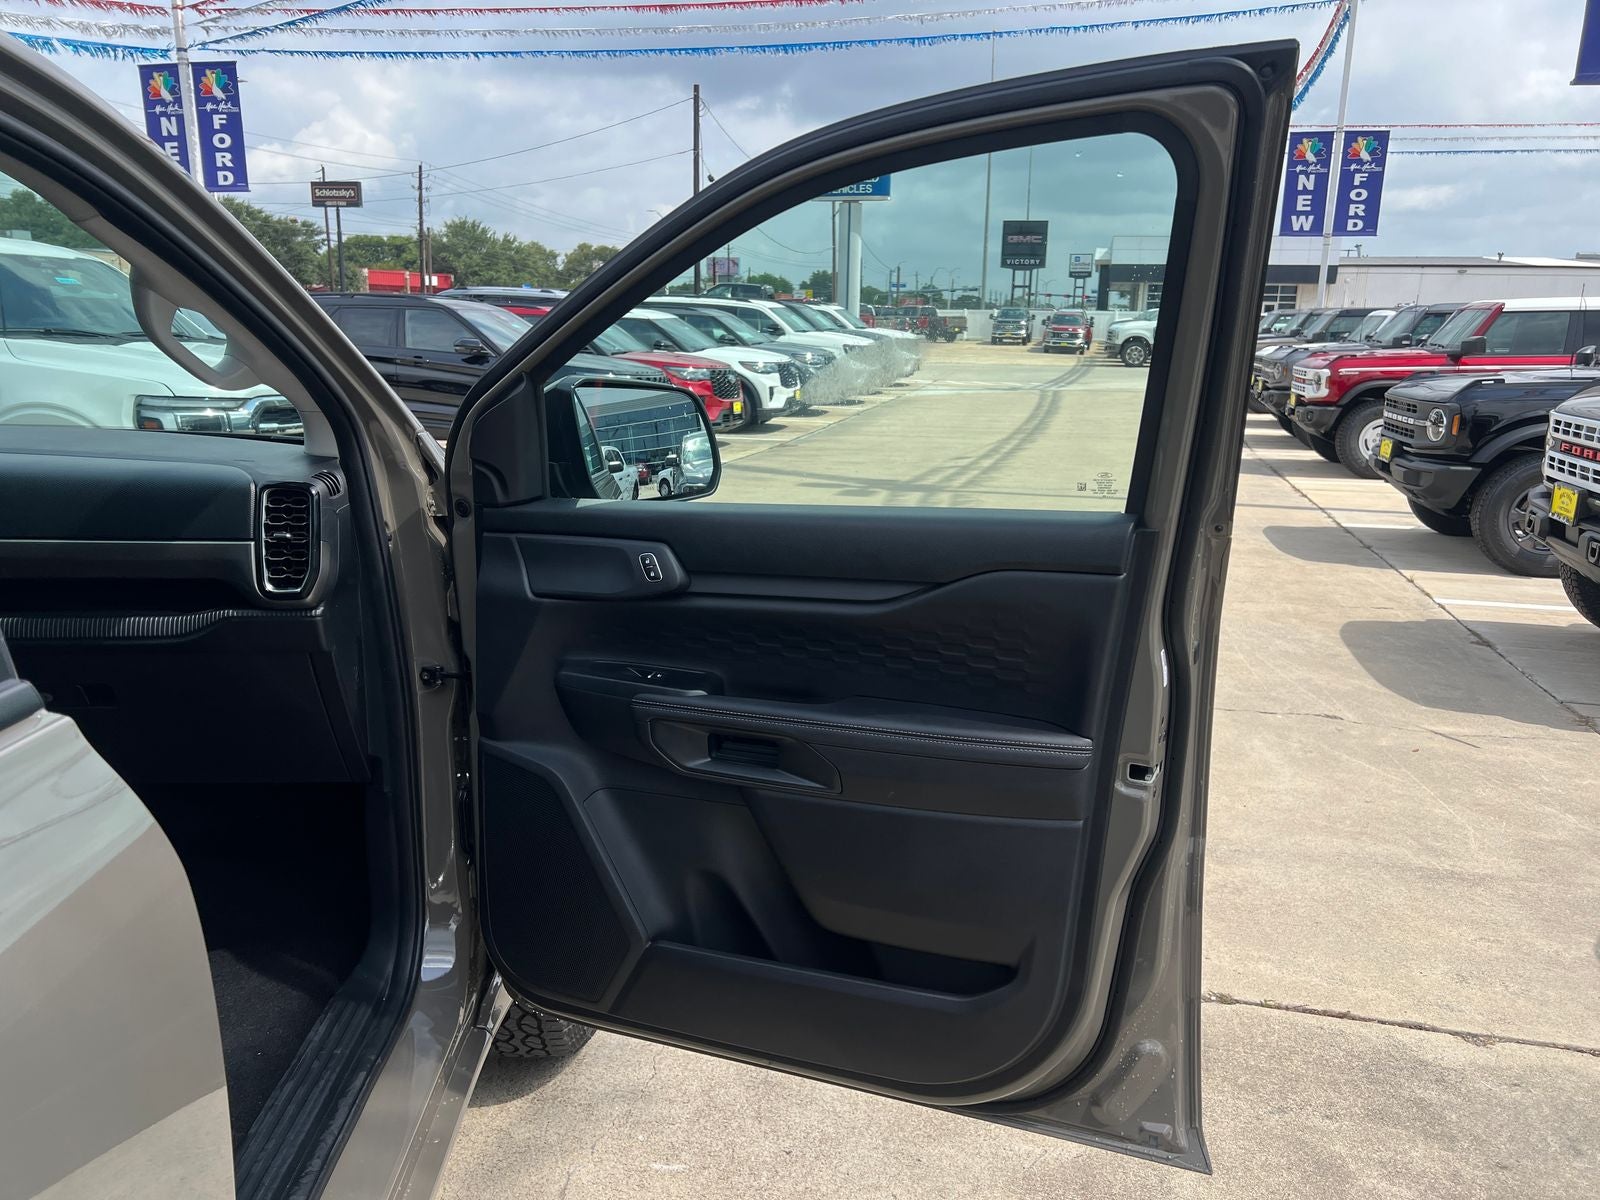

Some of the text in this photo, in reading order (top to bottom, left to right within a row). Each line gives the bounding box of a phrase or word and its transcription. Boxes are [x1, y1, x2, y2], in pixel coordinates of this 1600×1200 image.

[160, 116, 180, 161] NE
[212, 114, 235, 186] FORD
[828, 184, 873, 194] HICLES
[1291, 174, 1316, 231] NEW
[1346, 173, 1369, 231] FORD
[1007, 235, 1043, 243] GMC
